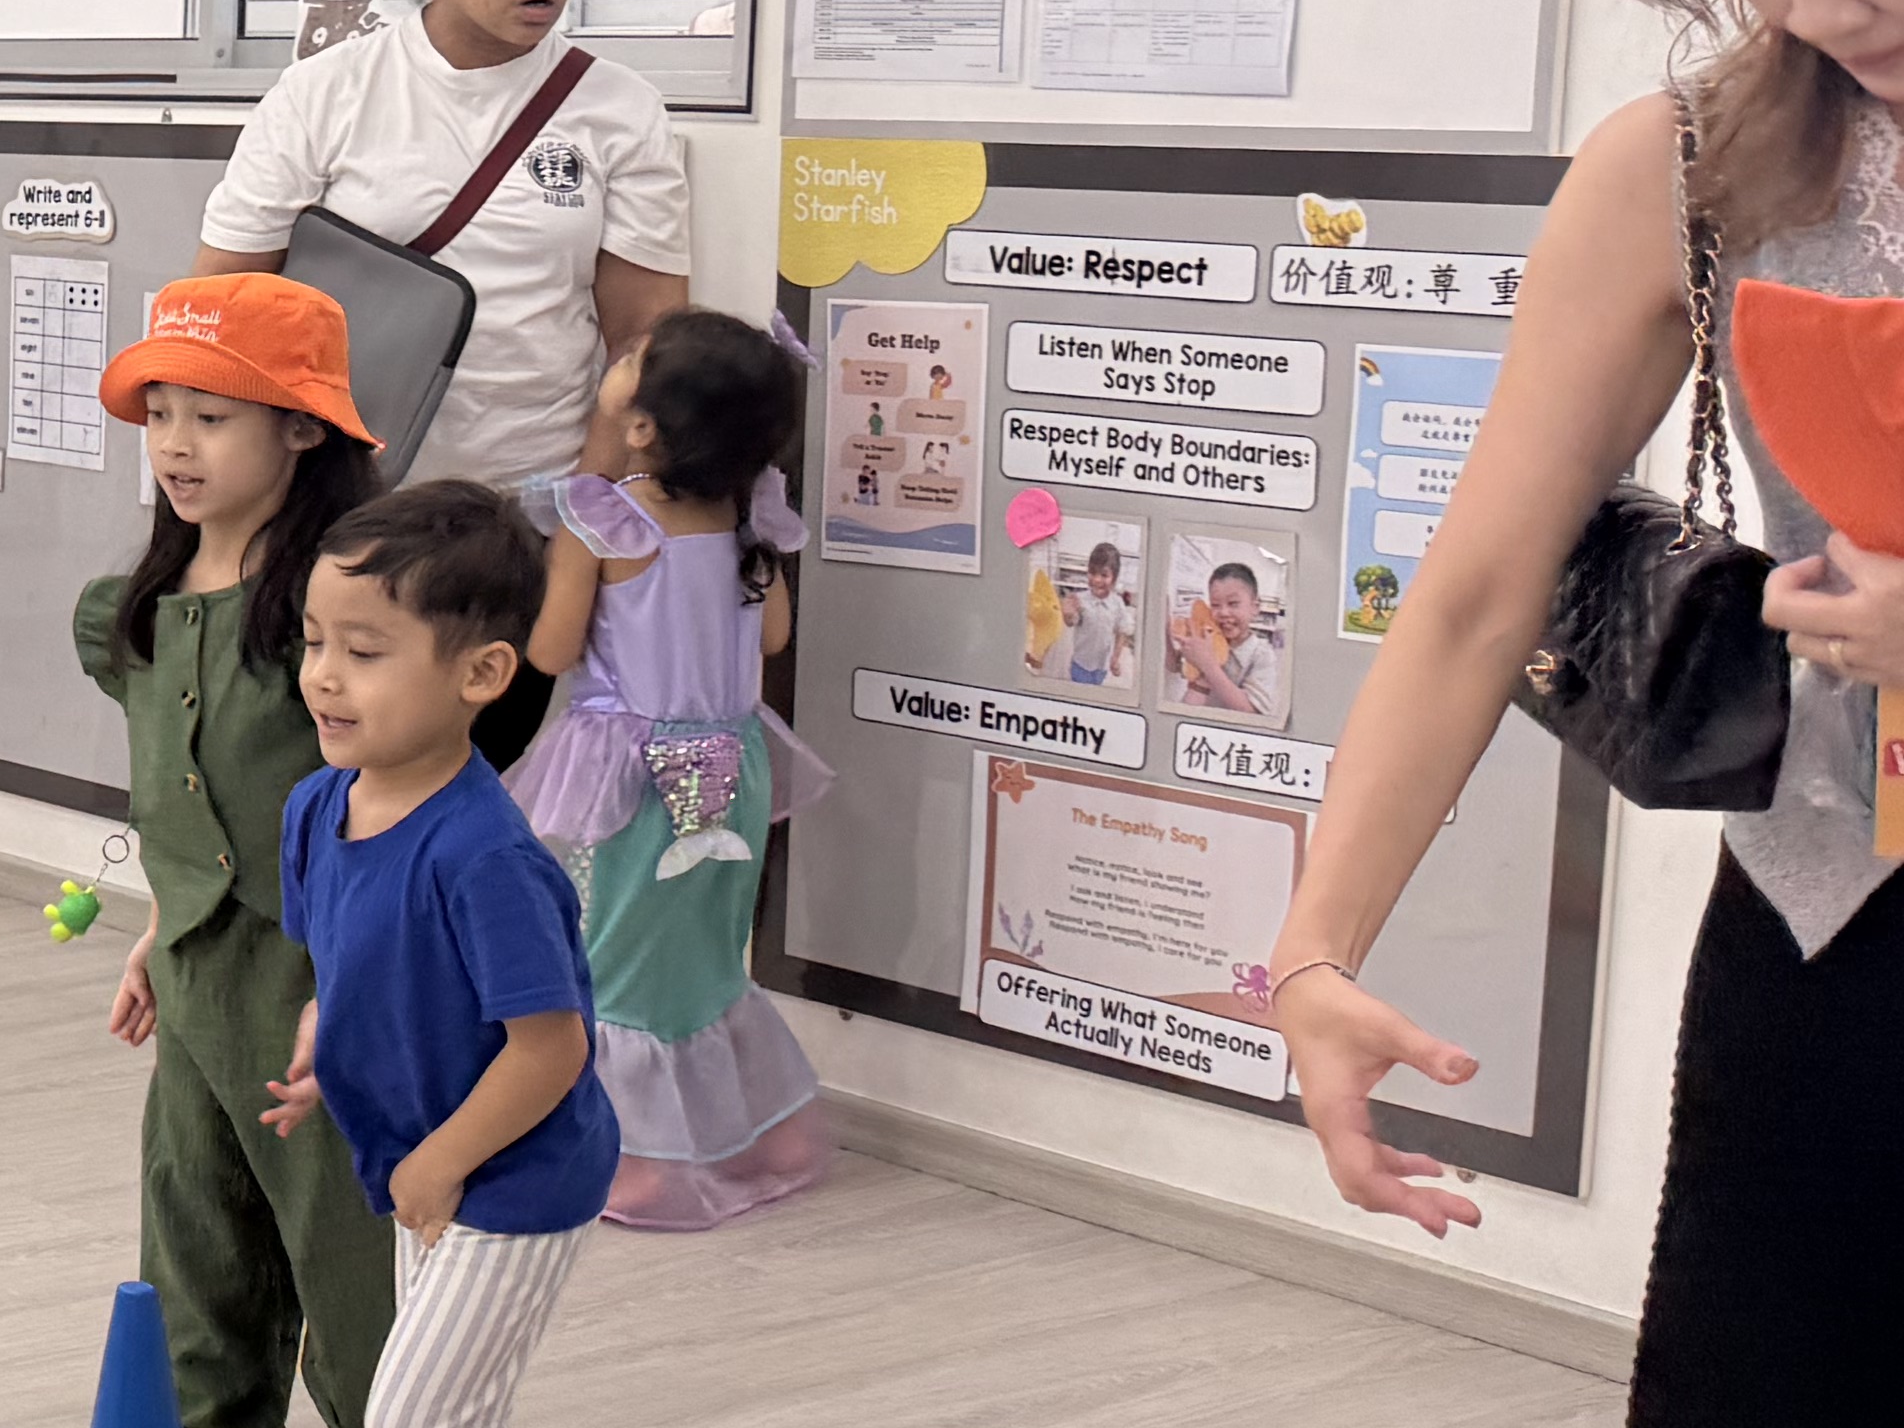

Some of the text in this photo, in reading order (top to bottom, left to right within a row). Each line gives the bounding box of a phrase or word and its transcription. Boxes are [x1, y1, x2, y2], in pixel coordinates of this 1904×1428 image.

[23, 185, 92, 204] Write and
[794, 156, 886, 194] Stanley
[9, 210, 80, 229] represent
[794, 193, 897, 224] Starfish
[989, 245, 1208, 288] Value: Respect
[867, 331, 941, 353] Get Help
[1039, 333, 1289, 374] Listen When Someone
[1103, 367, 1216, 400] Says Stop
[1009, 418, 1311, 469] Respect Body Boundaries:
[1047, 450, 1266, 494] Myself and Others
[890, 685, 1106, 754] Value: Empathy
[1072, 807, 1208, 852] The Empathy Song
[997, 972, 1272, 1060] Offering What Someone
[1045, 1012, 1212, 1073] Actually Needs
